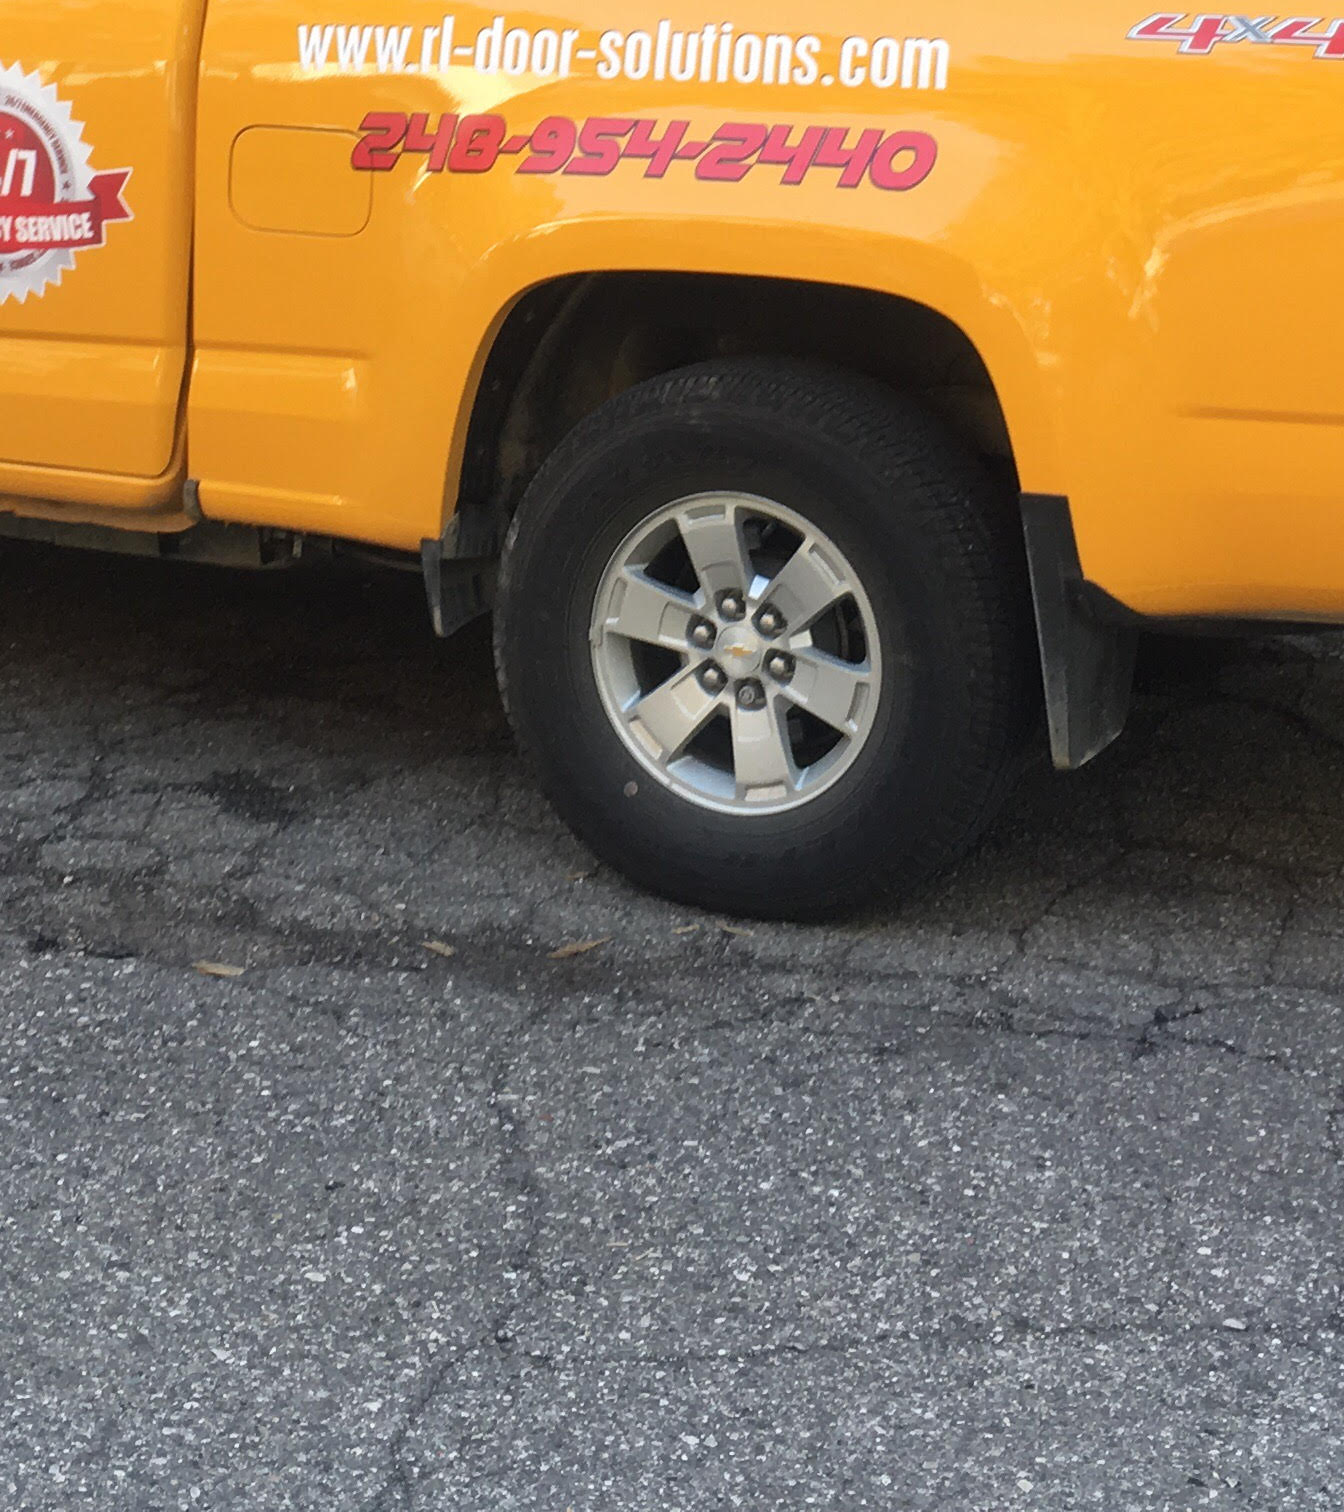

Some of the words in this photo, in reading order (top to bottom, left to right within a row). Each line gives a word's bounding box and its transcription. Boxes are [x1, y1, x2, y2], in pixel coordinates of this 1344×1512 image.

[297, 15, 950, 90] www.rl-door-solutions.com
[350, 111, 939, 192] 248-954-2440
[15, 211, 95, 243] SERVICE
